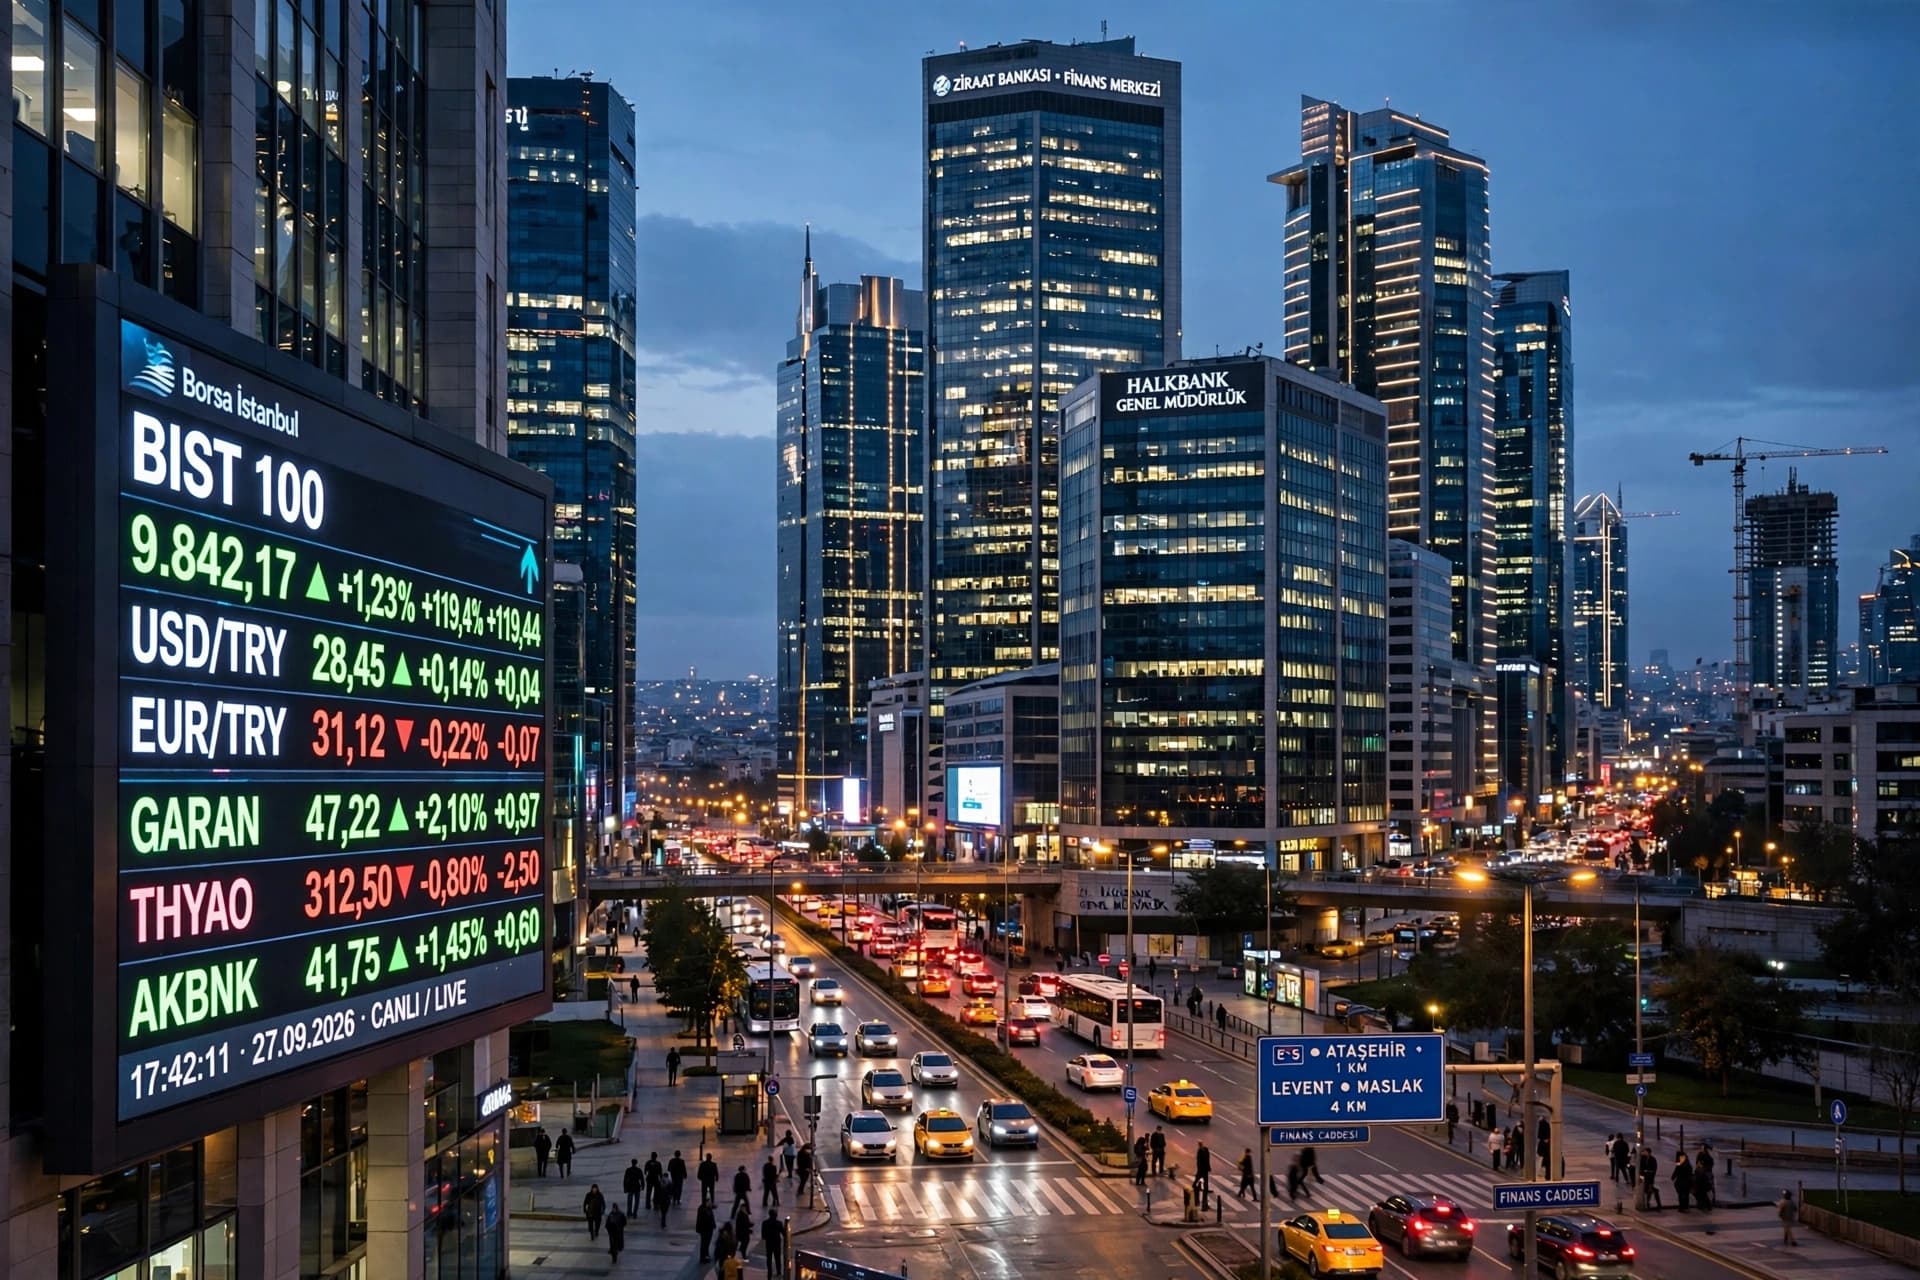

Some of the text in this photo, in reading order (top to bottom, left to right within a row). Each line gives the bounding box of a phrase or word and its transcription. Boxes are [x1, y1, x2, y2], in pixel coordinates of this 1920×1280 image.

[952, 68, 1161, 97] ZİRAAT BANKASI FİNANS MERKEZİ
[183, 367, 298, 437] Borsa İstanbul
[1116, 387, 1247, 412] GENEL MÜDÜRLÜK
[1127, 371, 1230, 396] HALKBANK
[134, 409, 323, 529] BIST 100
[131, 512, 541, 651] 9.842,17 +1,23% +119,4% +119,44
[132, 606, 540, 709] USD/TRY 28,45 +0,14% +0,04
[132, 697, 539, 768] EUR/TRY 31,12 -0,22% -0,07
[131, 793, 539, 853] GARAN 47,22 +2,10% +0,97
[130, 850, 539, 944] THYAO 312,50 -0,80% -2,50
[128, 908, 539, 1038] AKBNK 41,75 +1,45% +0,60
[131, 1042, 228, 1099] 17:42:11
[253, 1009, 355, 1065] 27.09.2026
[372, 992, 419, 1028] CANLI
[436, 979, 466, 1011] LIVE
[1326, 1040, 1406, 1061] ATAŞEHİR
[1336, 1062, 1367, 1073] 1 KM
[1272, 1078, 1423, 1096] LEVENT MASLAK
[1330, 1100, 1367, 1113] 4 KM
